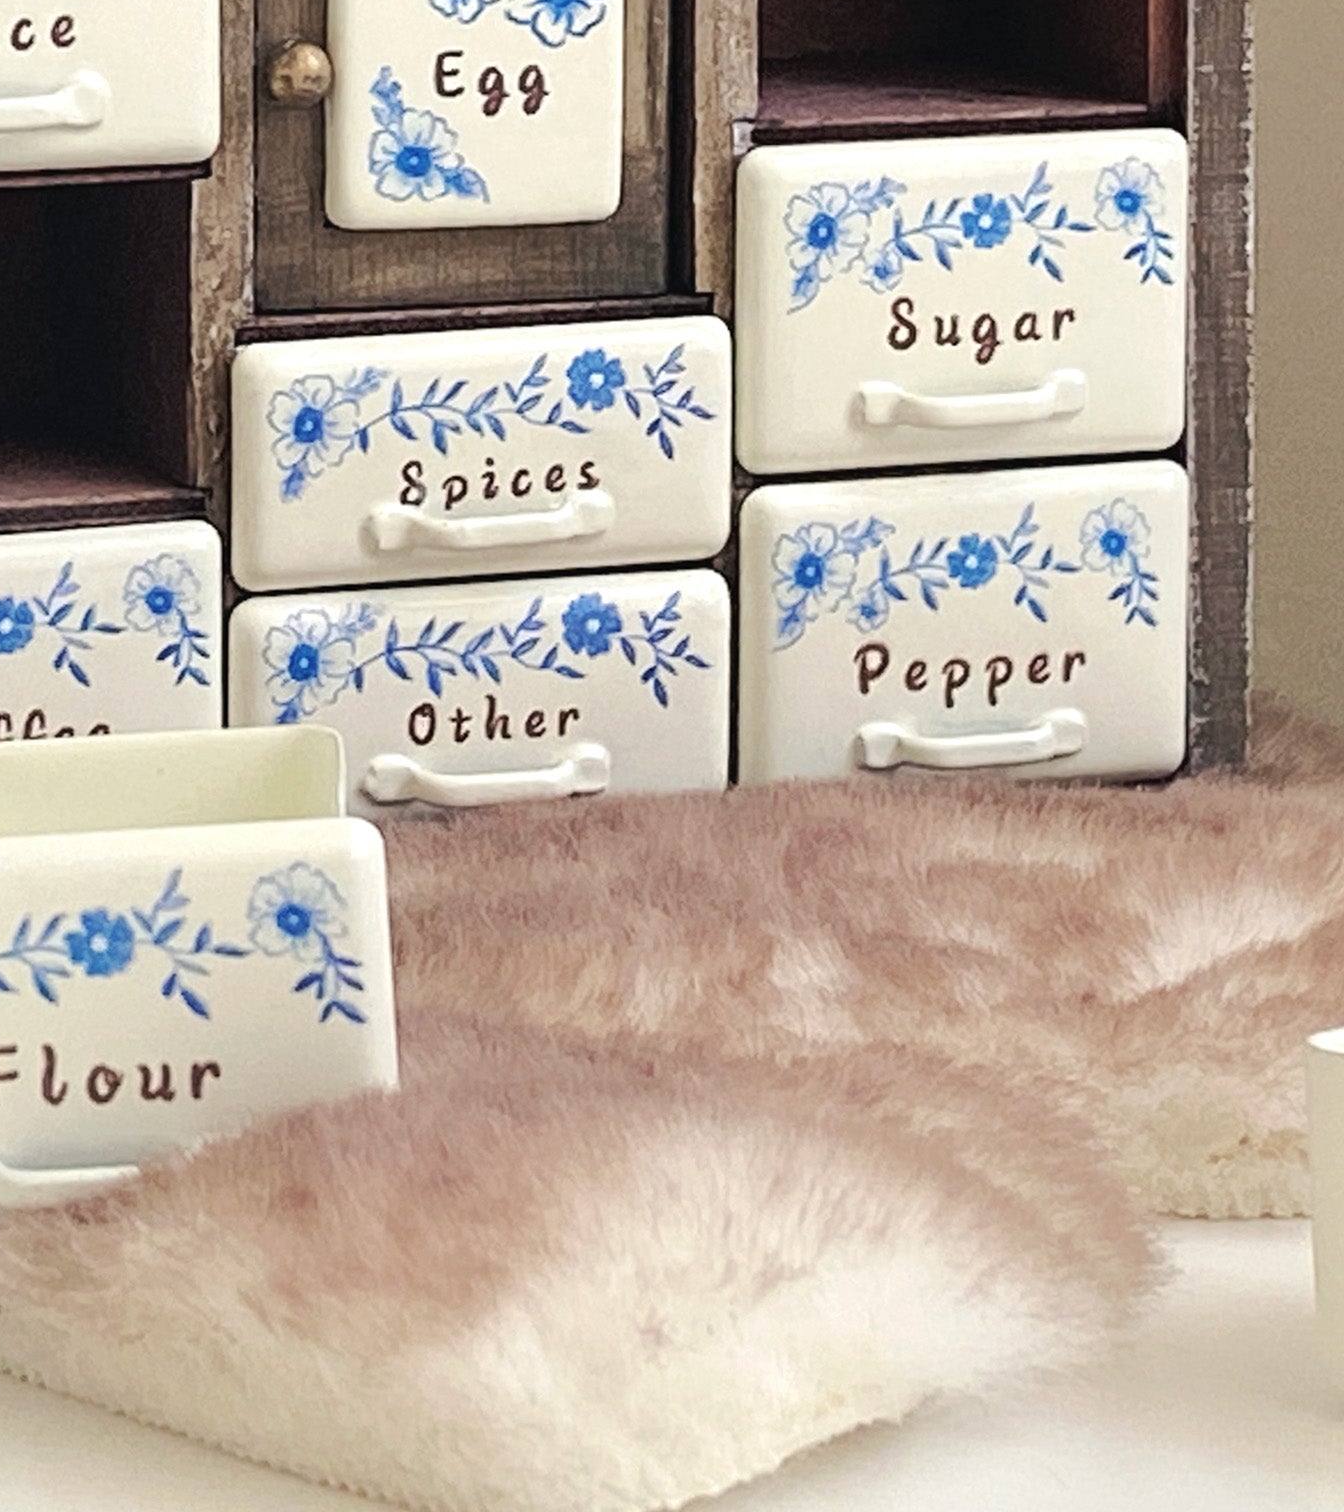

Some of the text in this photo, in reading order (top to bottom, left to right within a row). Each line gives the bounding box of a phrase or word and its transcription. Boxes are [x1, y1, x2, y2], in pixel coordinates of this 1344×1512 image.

[434, 50, 551, 117] Egg
[887, 296, 1077, 366] Sugar
[398, 456, 602, 513] Spices
[852, 641, 1088, 710] Pepper
[406, 693, 582, 748] Other
